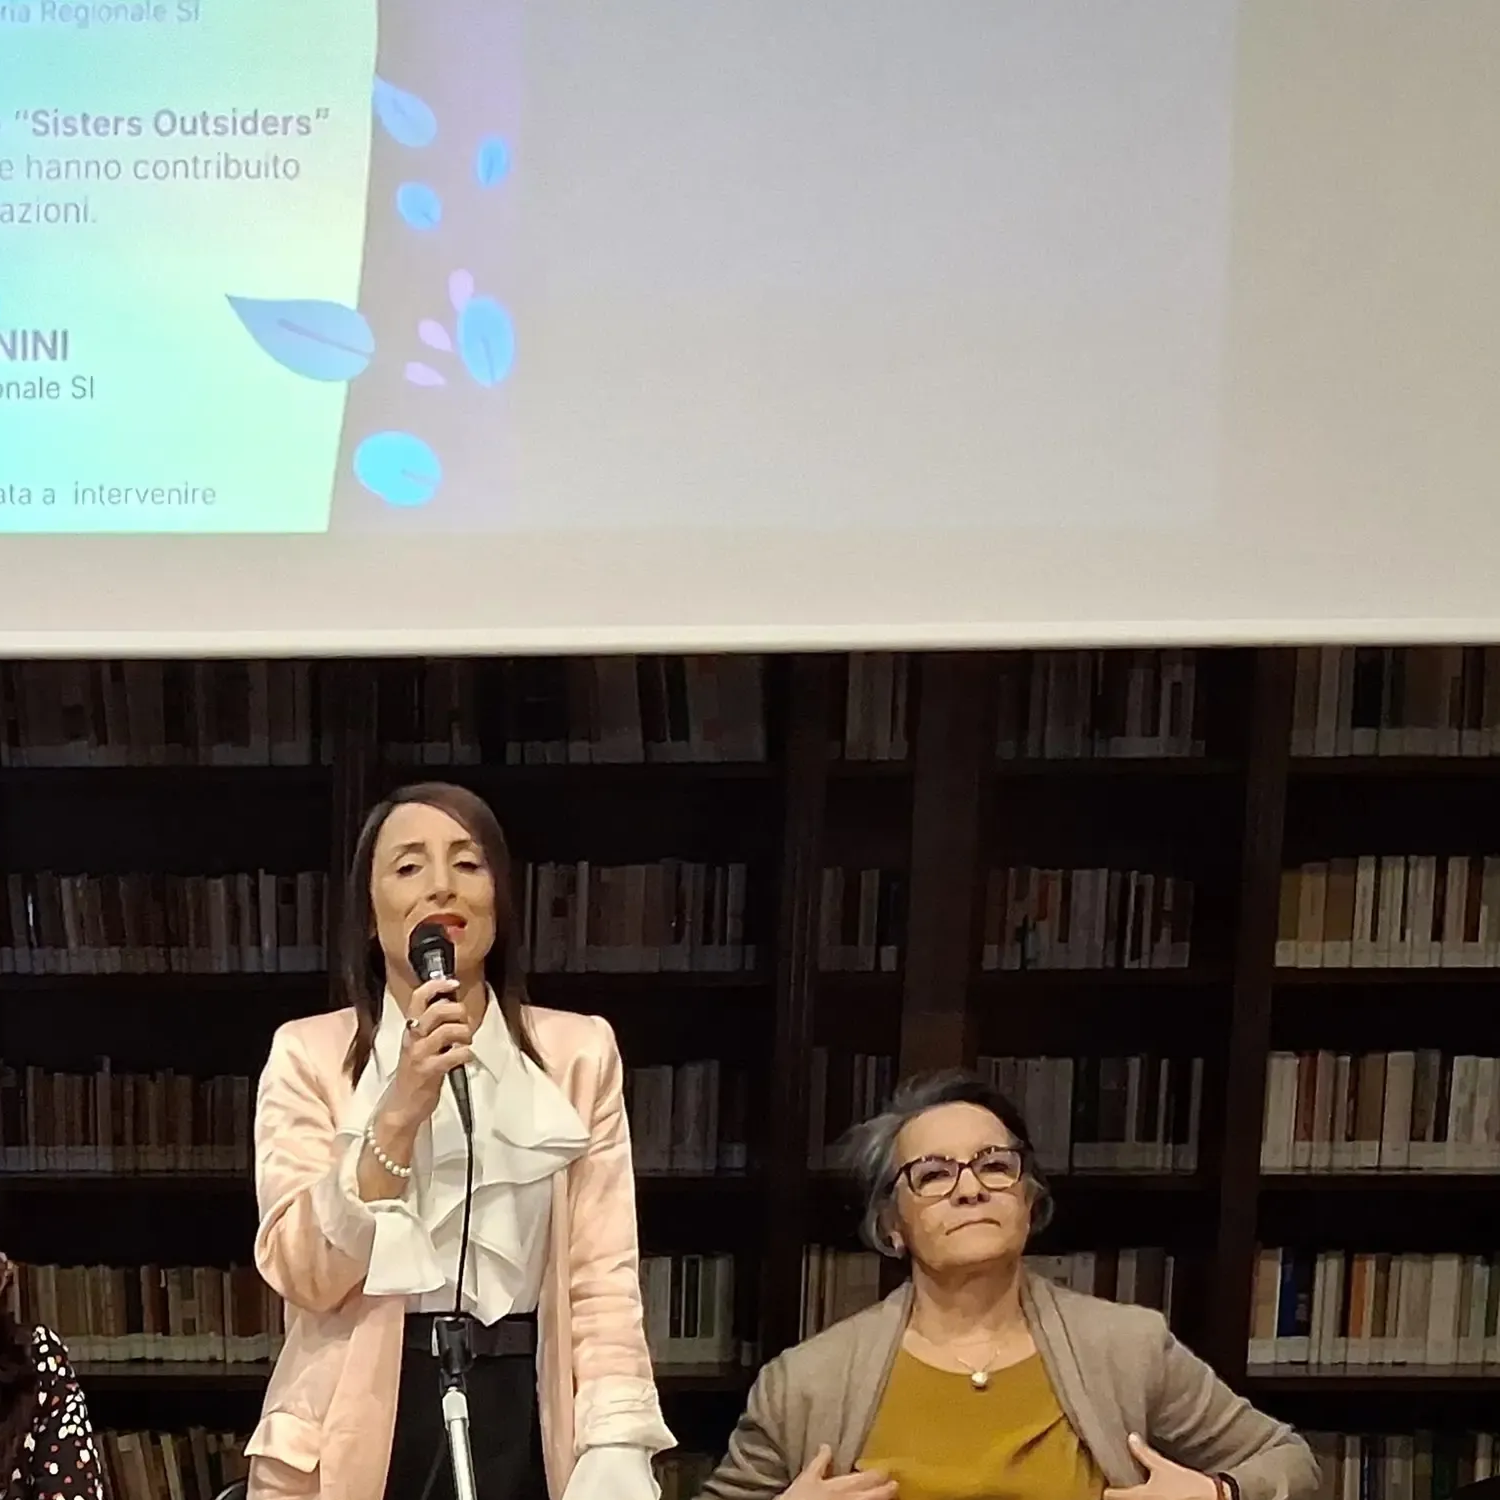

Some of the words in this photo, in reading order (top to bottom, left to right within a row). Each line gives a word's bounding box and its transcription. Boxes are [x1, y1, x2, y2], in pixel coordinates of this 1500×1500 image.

[25, 154, 122, 181] hanno
[132, 152, 301, 181] contribuito
[71, 375, 96, 400] SI
[42, 487, 57, 506] a
[73, 481, 217, 506] intervenire
